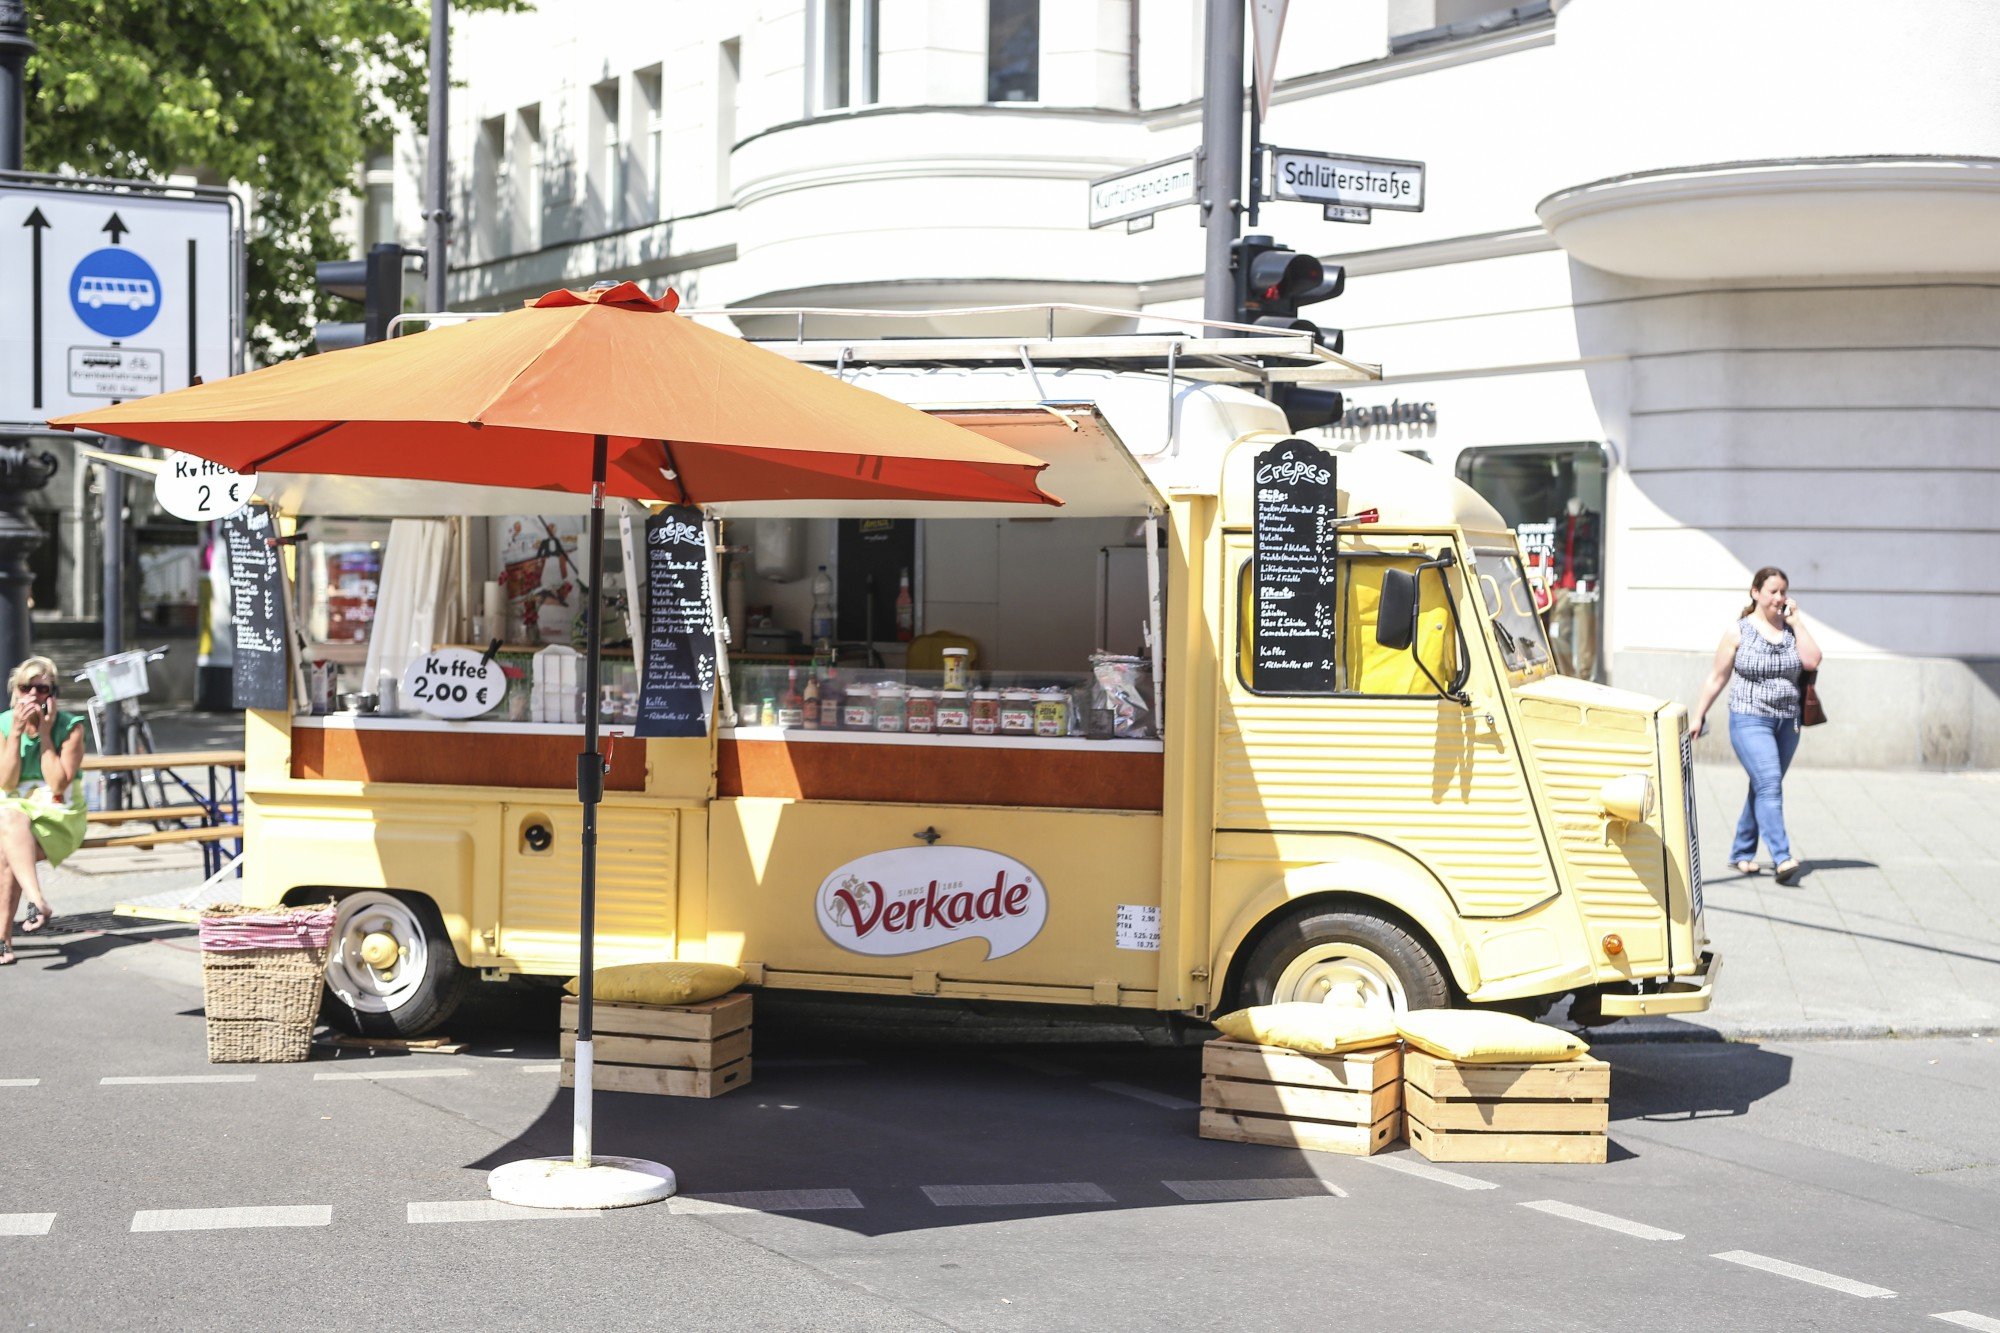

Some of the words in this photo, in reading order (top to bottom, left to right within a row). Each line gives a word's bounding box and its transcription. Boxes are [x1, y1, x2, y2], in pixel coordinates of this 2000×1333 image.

[1095, 172, 1192, 209] Kurfürstendamm
[1285, 162, 1411, 198] Schlüterstraße
[1256, 450, 1331, 485] Crêpes
[198, 485, 211, 511] 2
[229, 483, 239, 502] €
[1316, 504, 1335, 515] 3,-
[648, 516, 705, 545] Crêpes
[1259, 523, 1296, 532] Marmelade
[1259, 533, 1283, 541] Nutella
[1260, 601, 1277, 610] Käse
[1260, 618, 1276, 627] Käse
[413, 676, 468, 702] 2,00
[476, 687, 488, 705] €
[898, 886, 925, 897] SINDS
[942, 881, 963, 890] 1886
[834, 870, 1029, 938] Verkade
